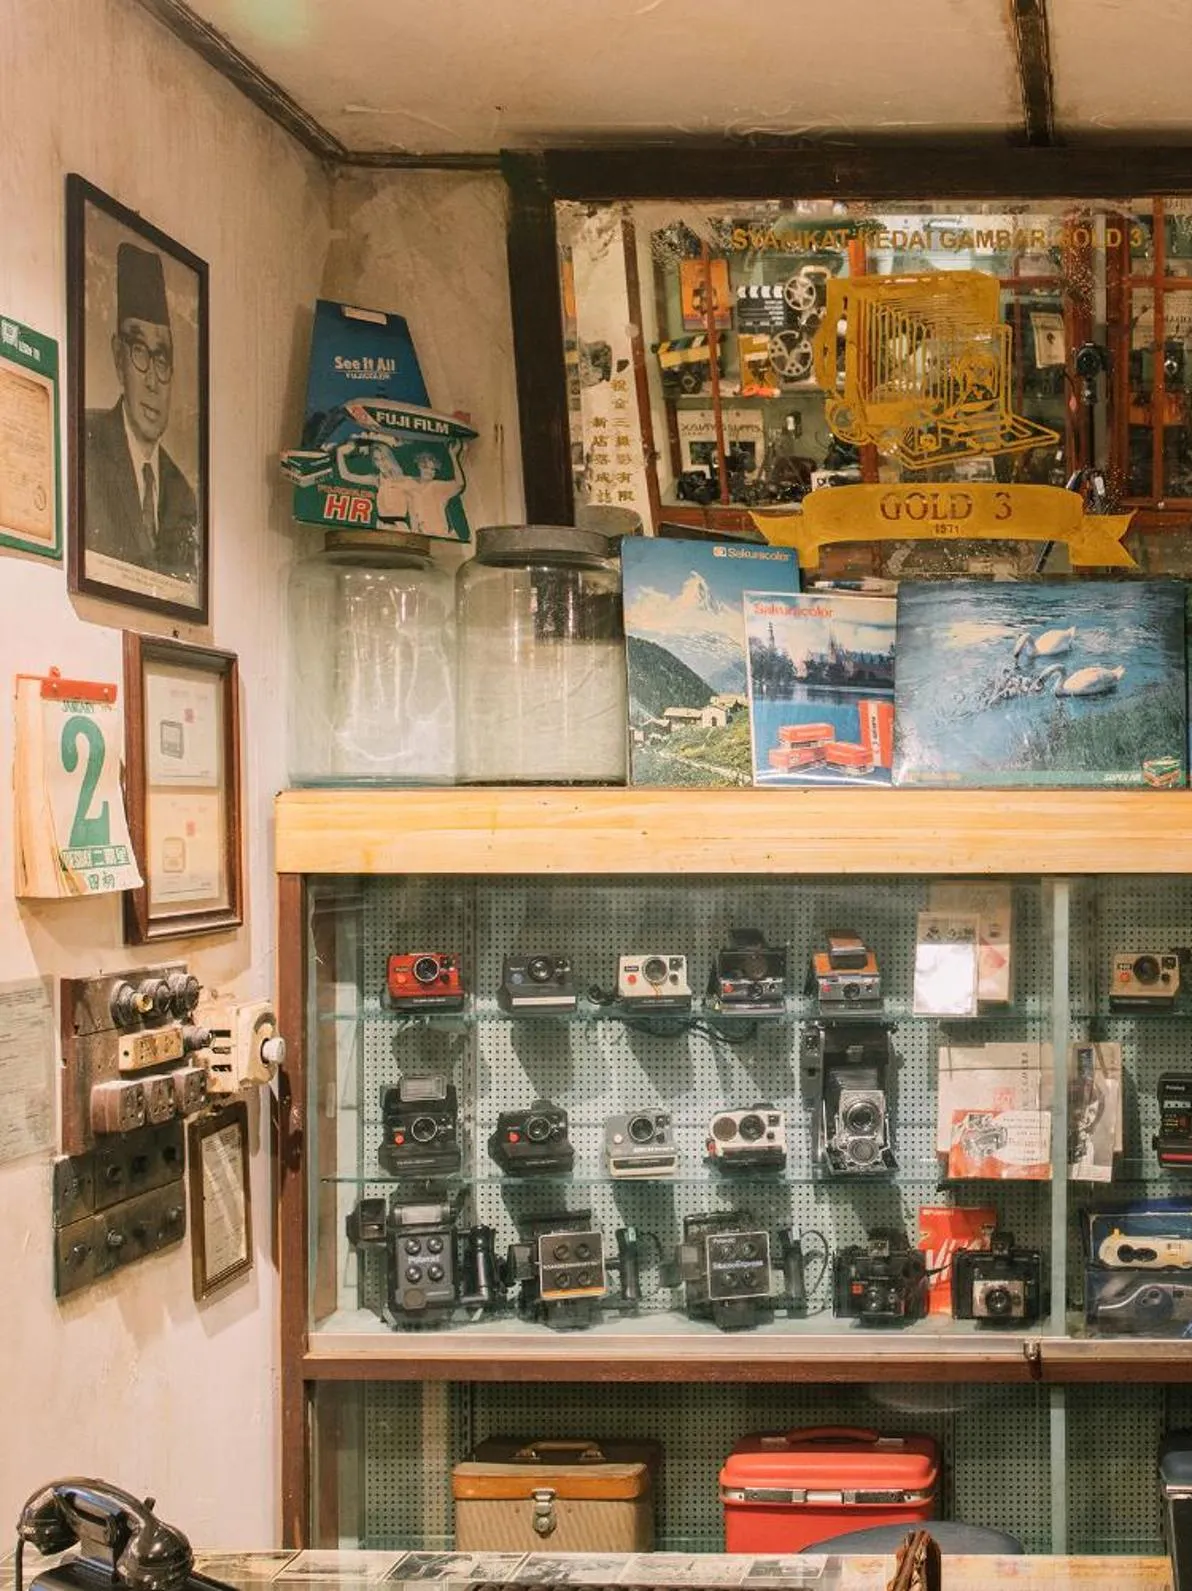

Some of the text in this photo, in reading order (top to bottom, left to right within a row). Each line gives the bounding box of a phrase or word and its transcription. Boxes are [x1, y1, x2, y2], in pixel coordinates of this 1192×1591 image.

[858, 228, 930, 249] KEDAI
[939, 229, 1046, 249] GAMBAR
[1130, 228, 1142, 248] 3
[335, 356, 361, 371] See
[377, 356, 396, 372] All
[376, 411, 450, 435] FUJI FILM
[323, 493, 374, 524] HR
[880, 492, 1013, 520] GOLD 3
[727, 547, 791, 561] Sakuracolor
[753, 603, 834, 618] Sakuracolor
[61, 715, 110, 848] 2
